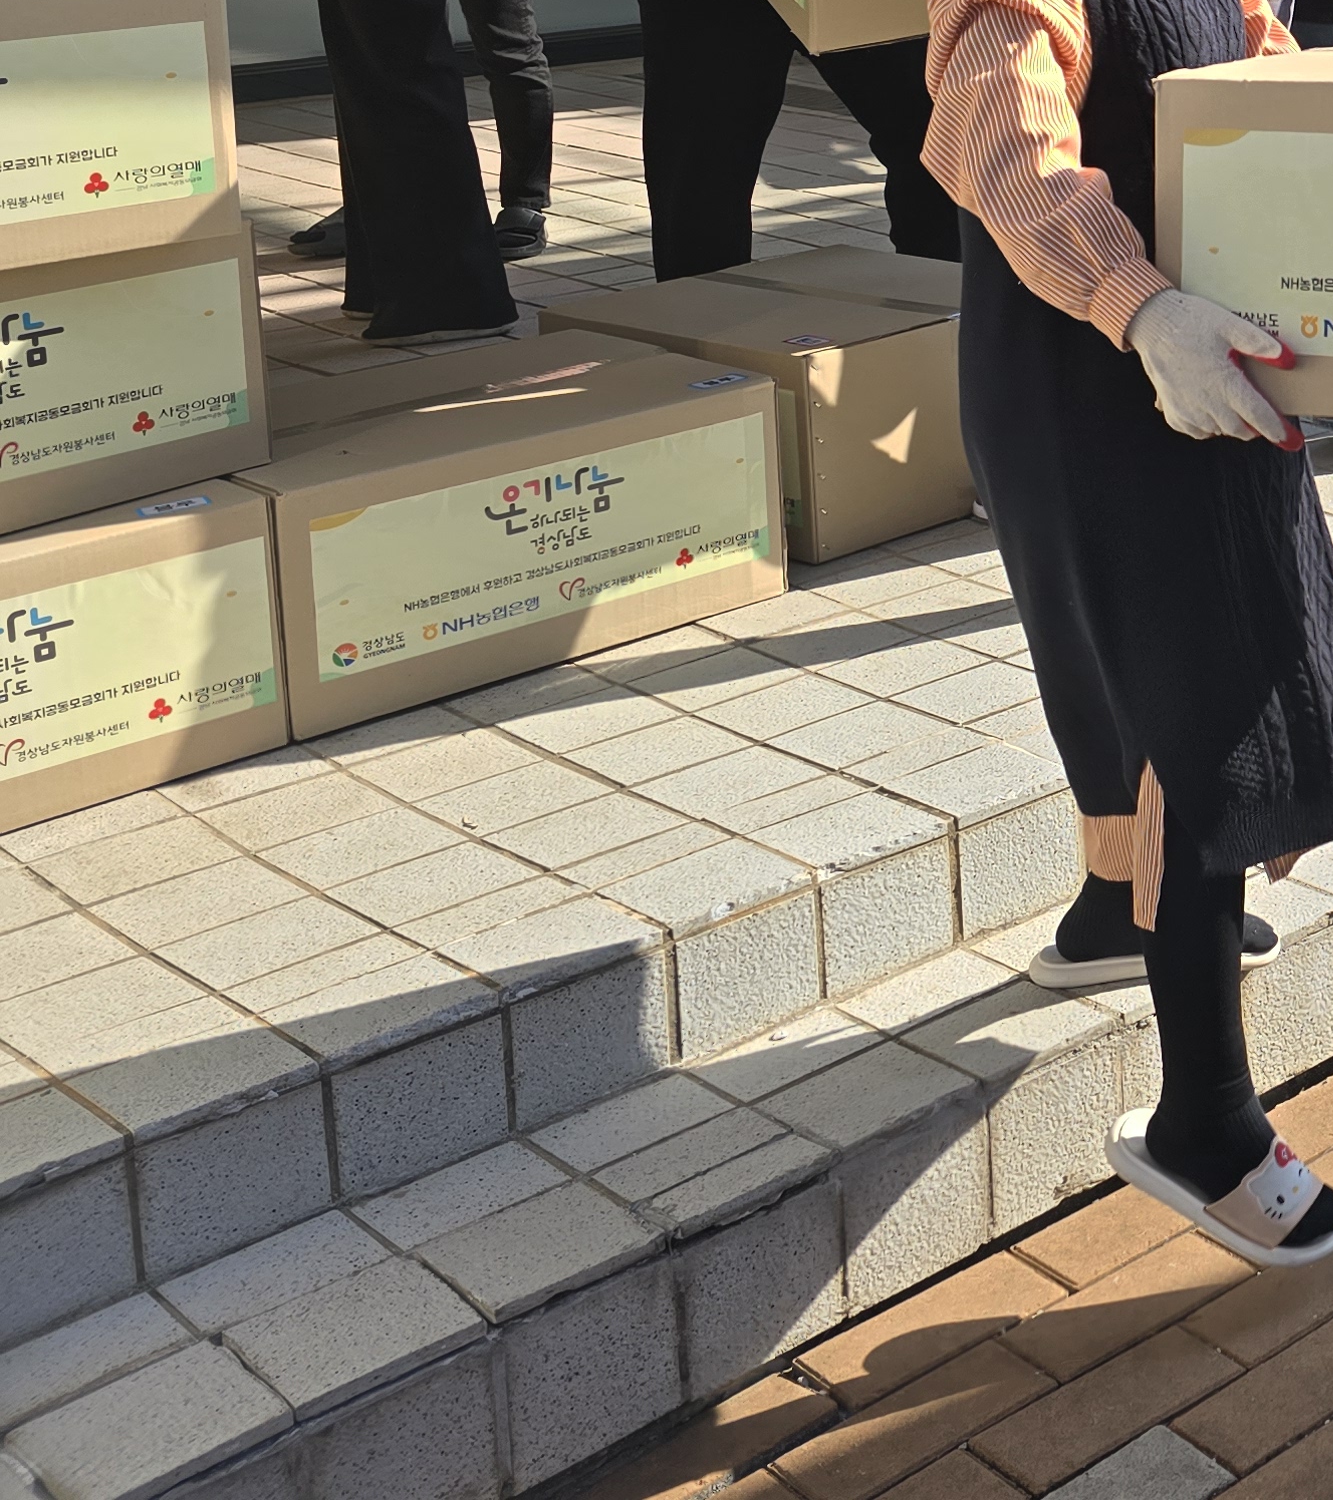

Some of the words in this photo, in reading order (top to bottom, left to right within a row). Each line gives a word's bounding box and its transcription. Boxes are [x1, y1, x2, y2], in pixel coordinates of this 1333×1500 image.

[56, 146, 118, 165] 지원합니다
[113, 160, 202, 184] 사랑의열매
[108, 384, 164, 405] 지원합니다
[158, 391, 237, 420] 사랑의열매
[10, 431, 116, 465] 경상남도자원봉사센터
[484, 465, 625, 536] 온기나눔
[530, 505, 590, 529] 하나되는
[530, 525, 592, 555] 경상남도
[697, 528, 760, 555] 사랑의열매
[404, 584, 480, 613] NH농협은행에서
[483, 572, 522, 592] 후원하고
[657, 523, 702, 546] 지원합니다
[442, 596, 540, 636] NH농협은행
[362, 631, 406, 652] 경상남도
[362, 642, 406, 660] GYEONGNAM
[121, 670, 181, 696] 지원합니다
[177, 671, 261, 705] 사랑의열매
[15, 720, 130, 763] 경상남도자원봉사센터
